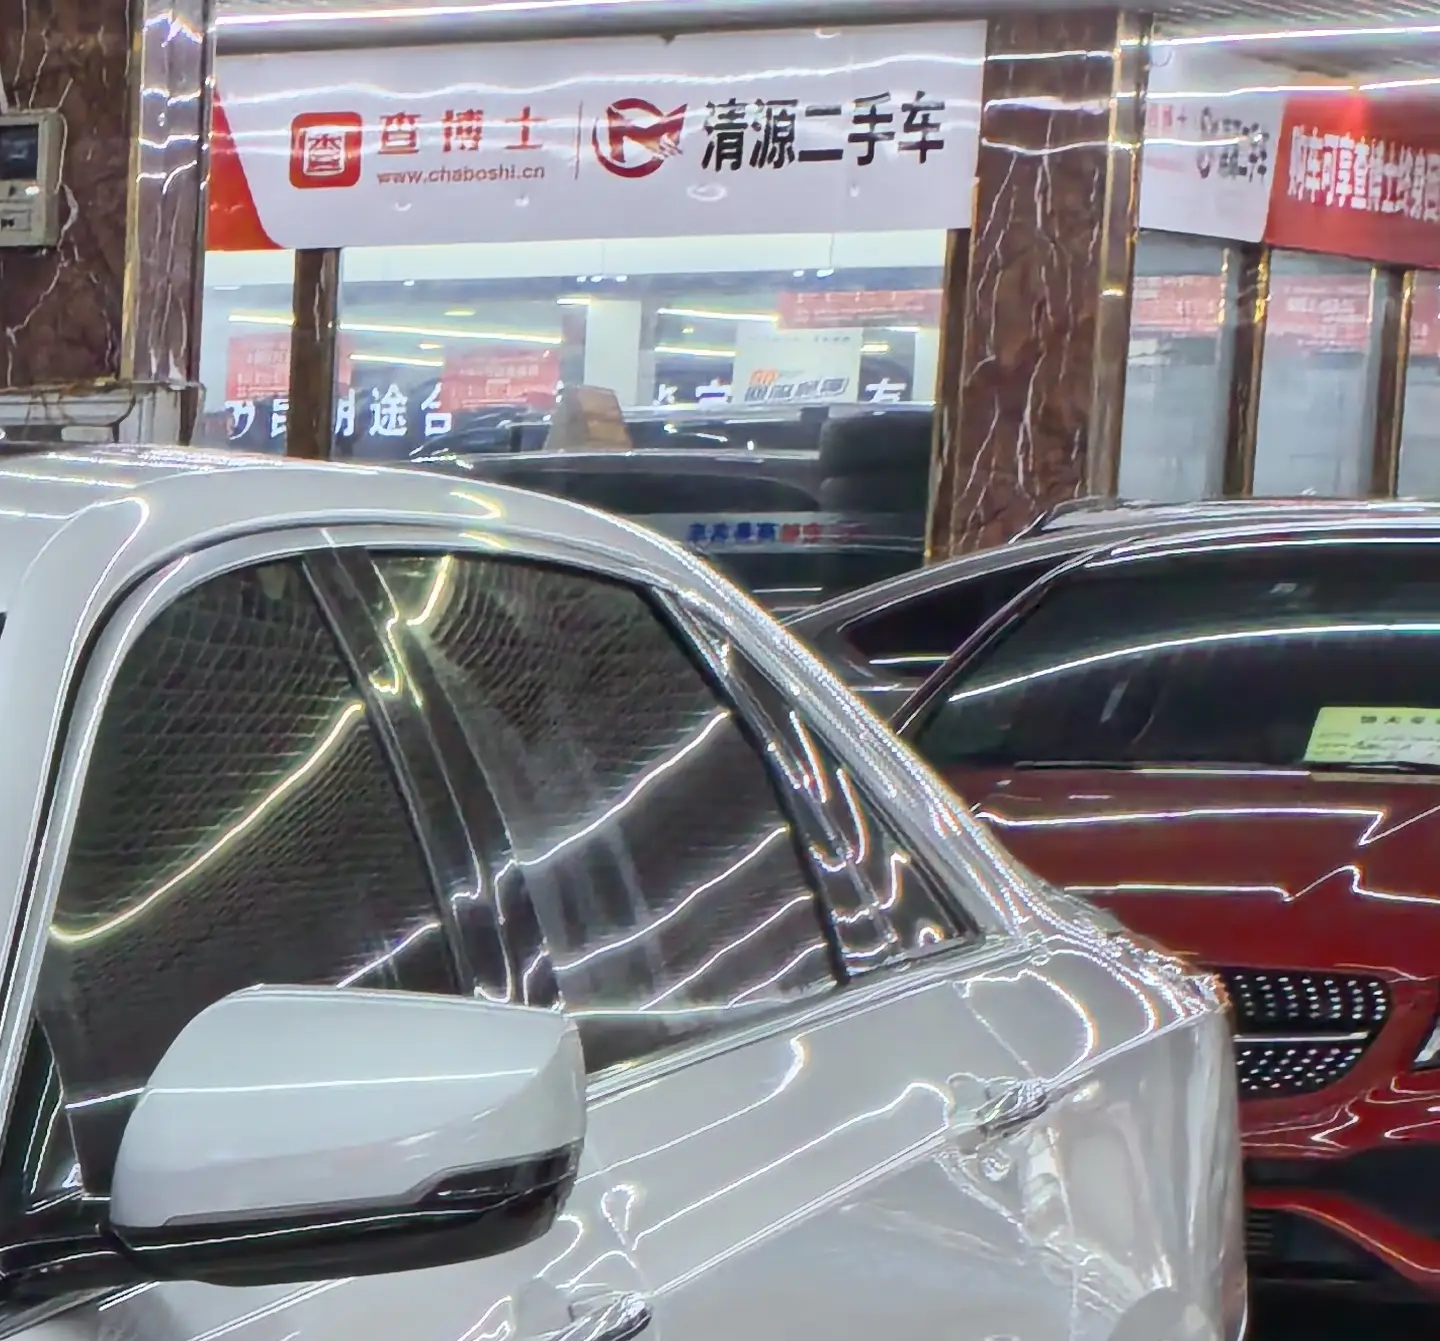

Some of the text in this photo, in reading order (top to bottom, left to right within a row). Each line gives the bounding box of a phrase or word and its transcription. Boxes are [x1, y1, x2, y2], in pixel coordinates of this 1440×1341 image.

[378, 104, 544, 156] 查博士
[702, 90, 947, 173] 清源二手车
[376, 164, 547, 185] www.chaboshi.cn
